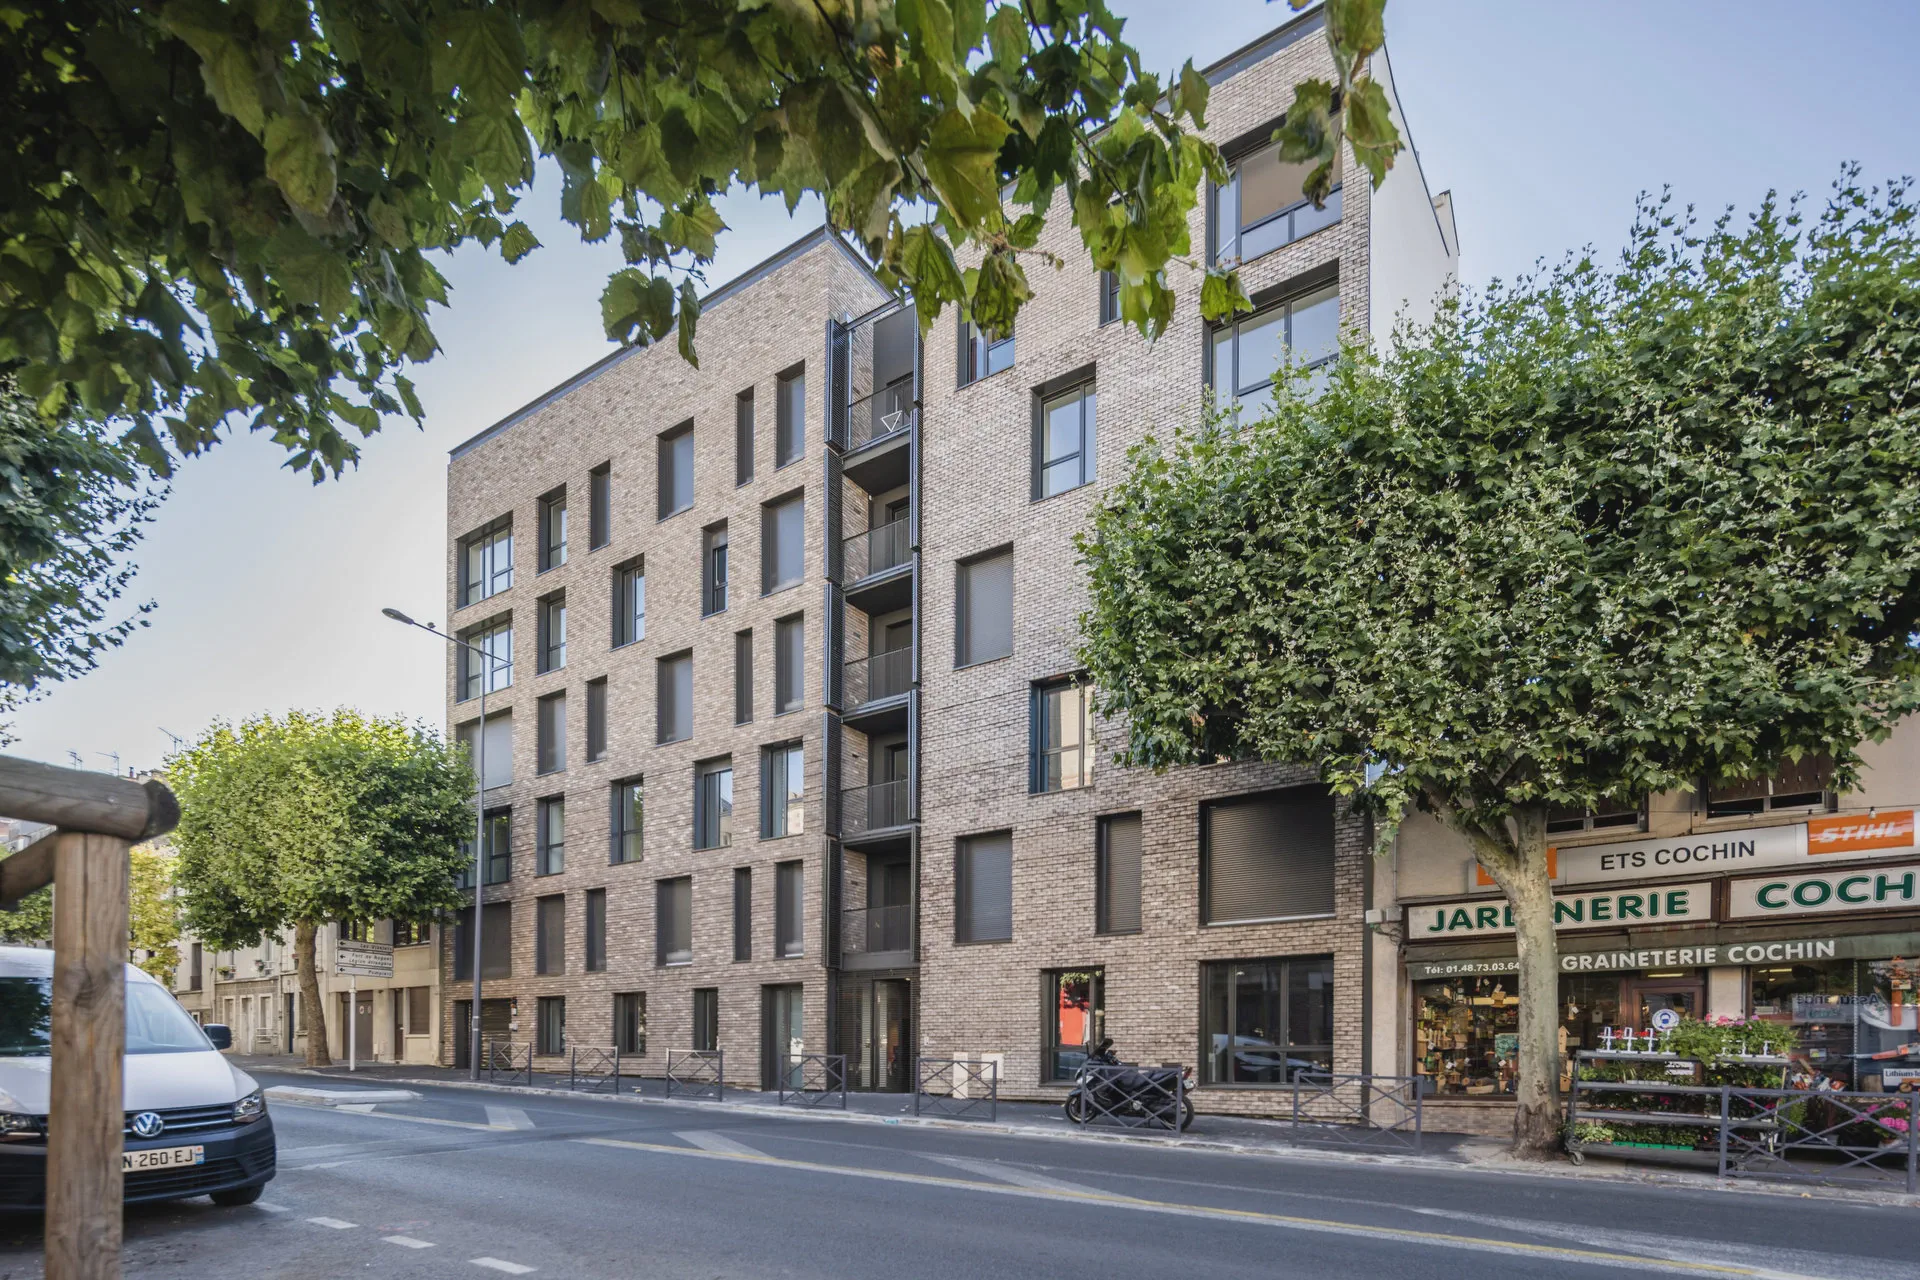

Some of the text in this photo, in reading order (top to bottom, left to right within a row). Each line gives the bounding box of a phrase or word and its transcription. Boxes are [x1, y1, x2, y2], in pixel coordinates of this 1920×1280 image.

[1819, 822, 1904, 843] STIHL
[1601, 840, 1755, 871] ETS COCHIN
[1561, 940, 1835, 971] GRAINETERIE COCHIN
[1446, 962, 1520, 974] 01.48.73.03.64
[123, 1149, 193, 1168] N-260-EJ
